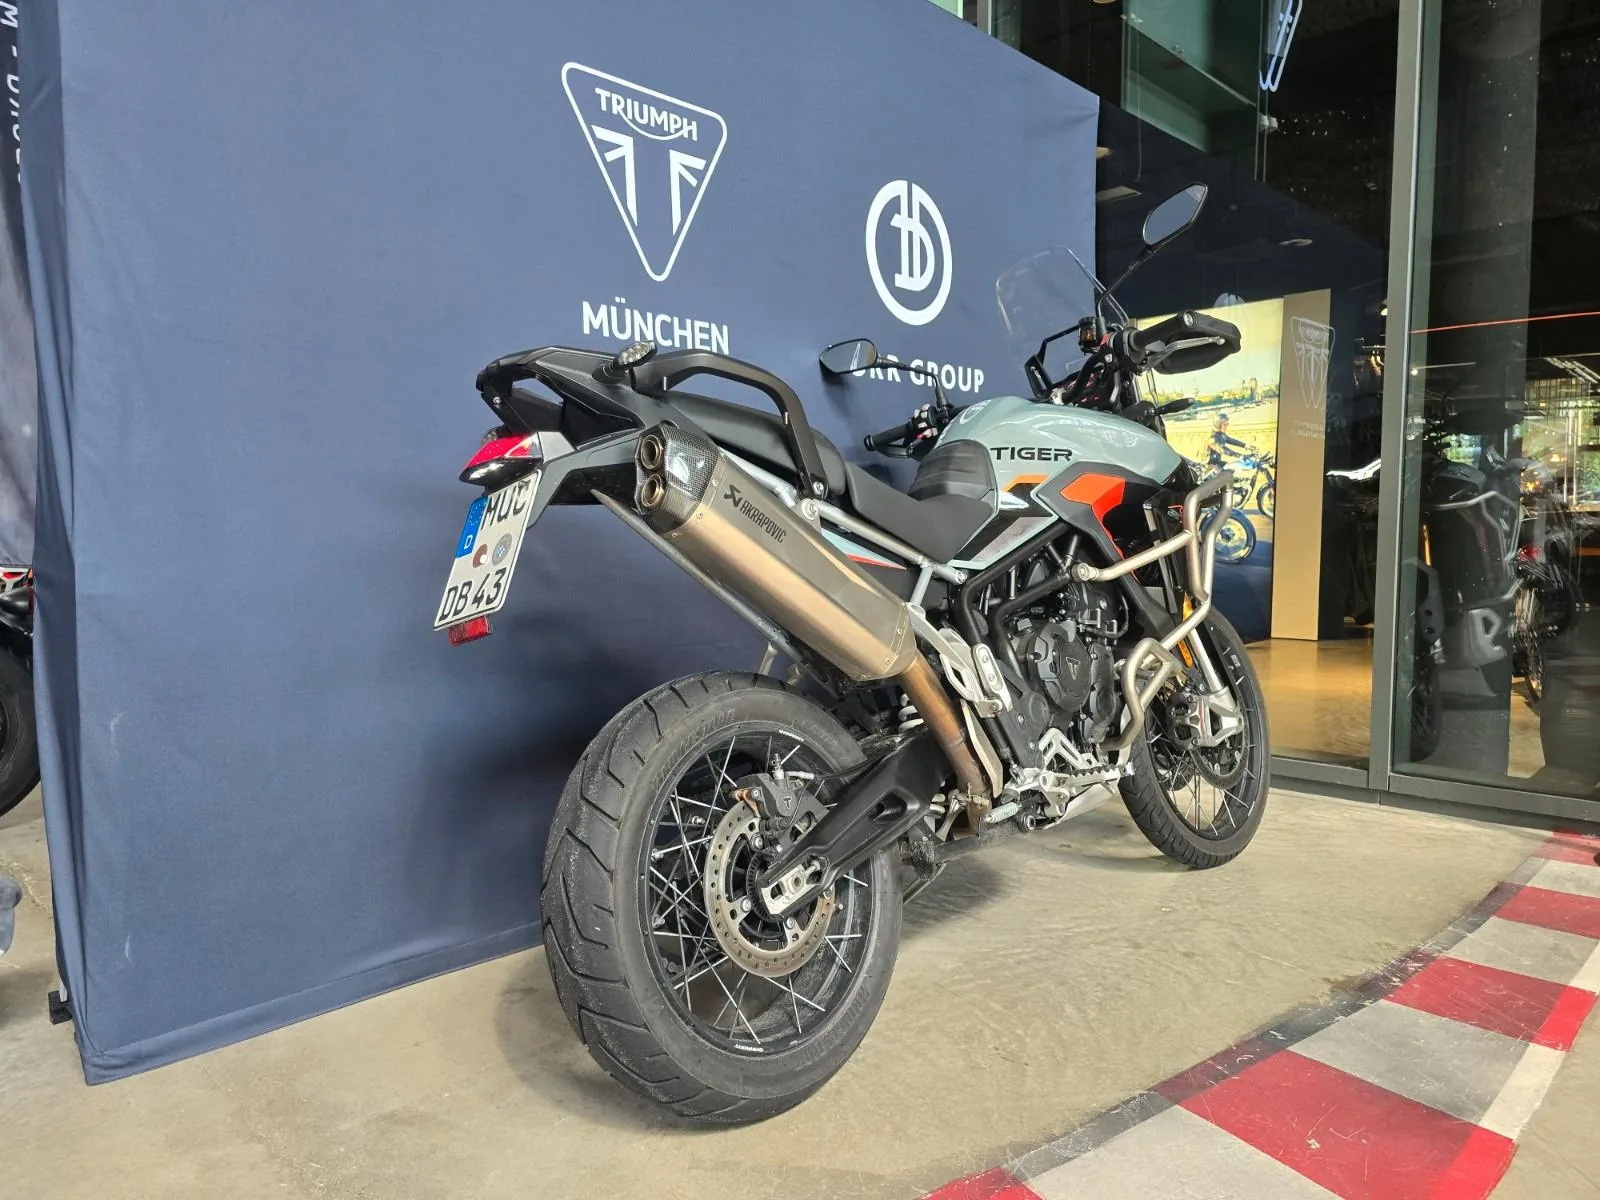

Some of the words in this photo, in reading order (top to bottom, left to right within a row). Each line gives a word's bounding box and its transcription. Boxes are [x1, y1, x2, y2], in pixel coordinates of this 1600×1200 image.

[595, 87, 698, 142] TRIUMPH
[582, 296, 730, 355] MÜNCHEN
[909, 358, 985, 393] GROUP
[990, 446, 1073, 462] TIGER
[480, 479, 532, 531] MUC
[439, 580, 473, 622] DB
[472, 567, 508, 609] 43
